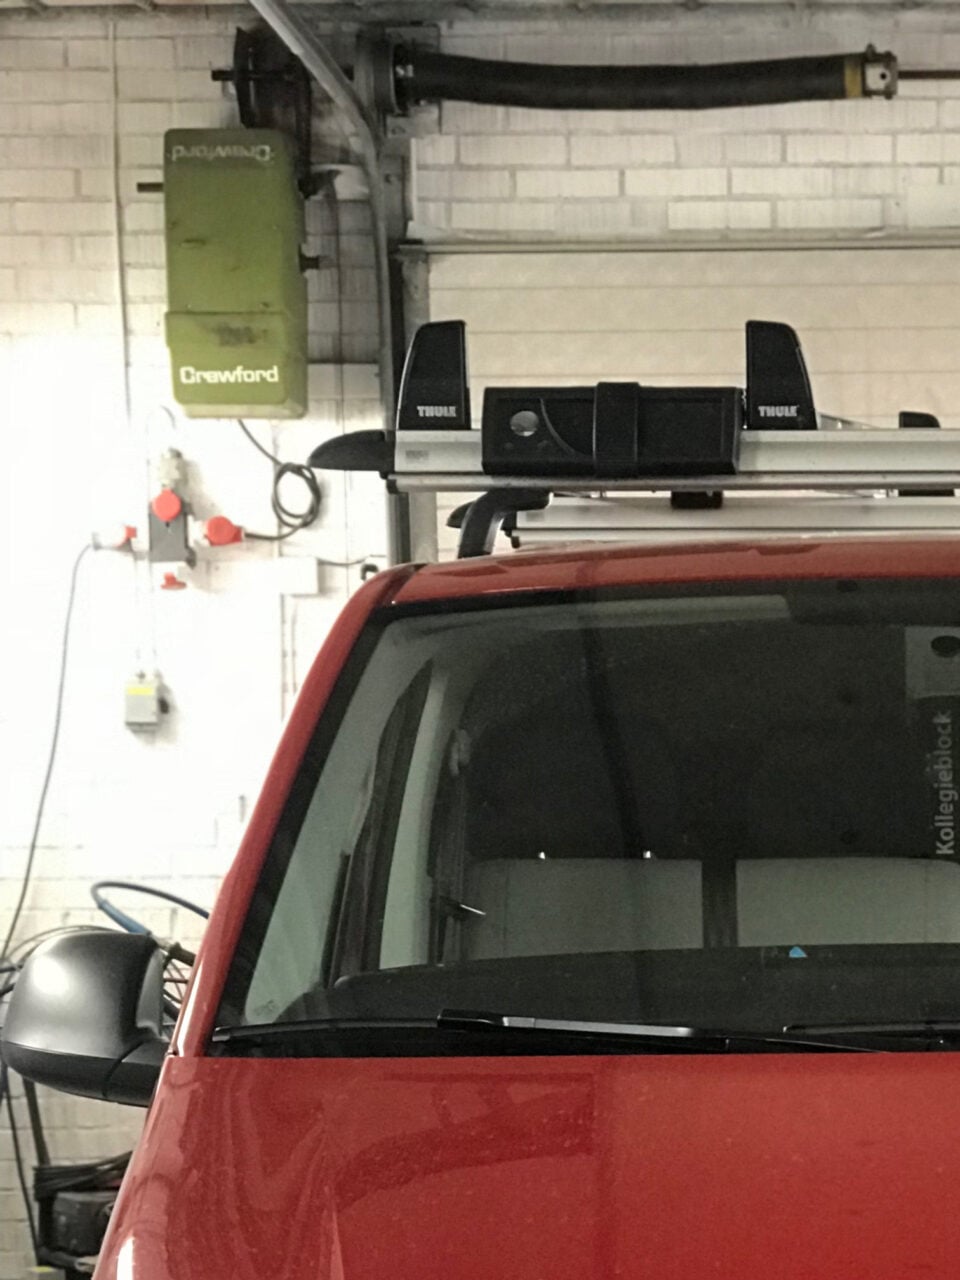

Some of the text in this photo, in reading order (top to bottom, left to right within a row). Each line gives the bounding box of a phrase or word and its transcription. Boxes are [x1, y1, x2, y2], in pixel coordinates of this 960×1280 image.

[179, 365, 279, 384] Crawford
[416, 405, 457, 418] THULE
[757, 405, 798, 418] THULE
[933, 709, 959, 855] Kollegieblock
